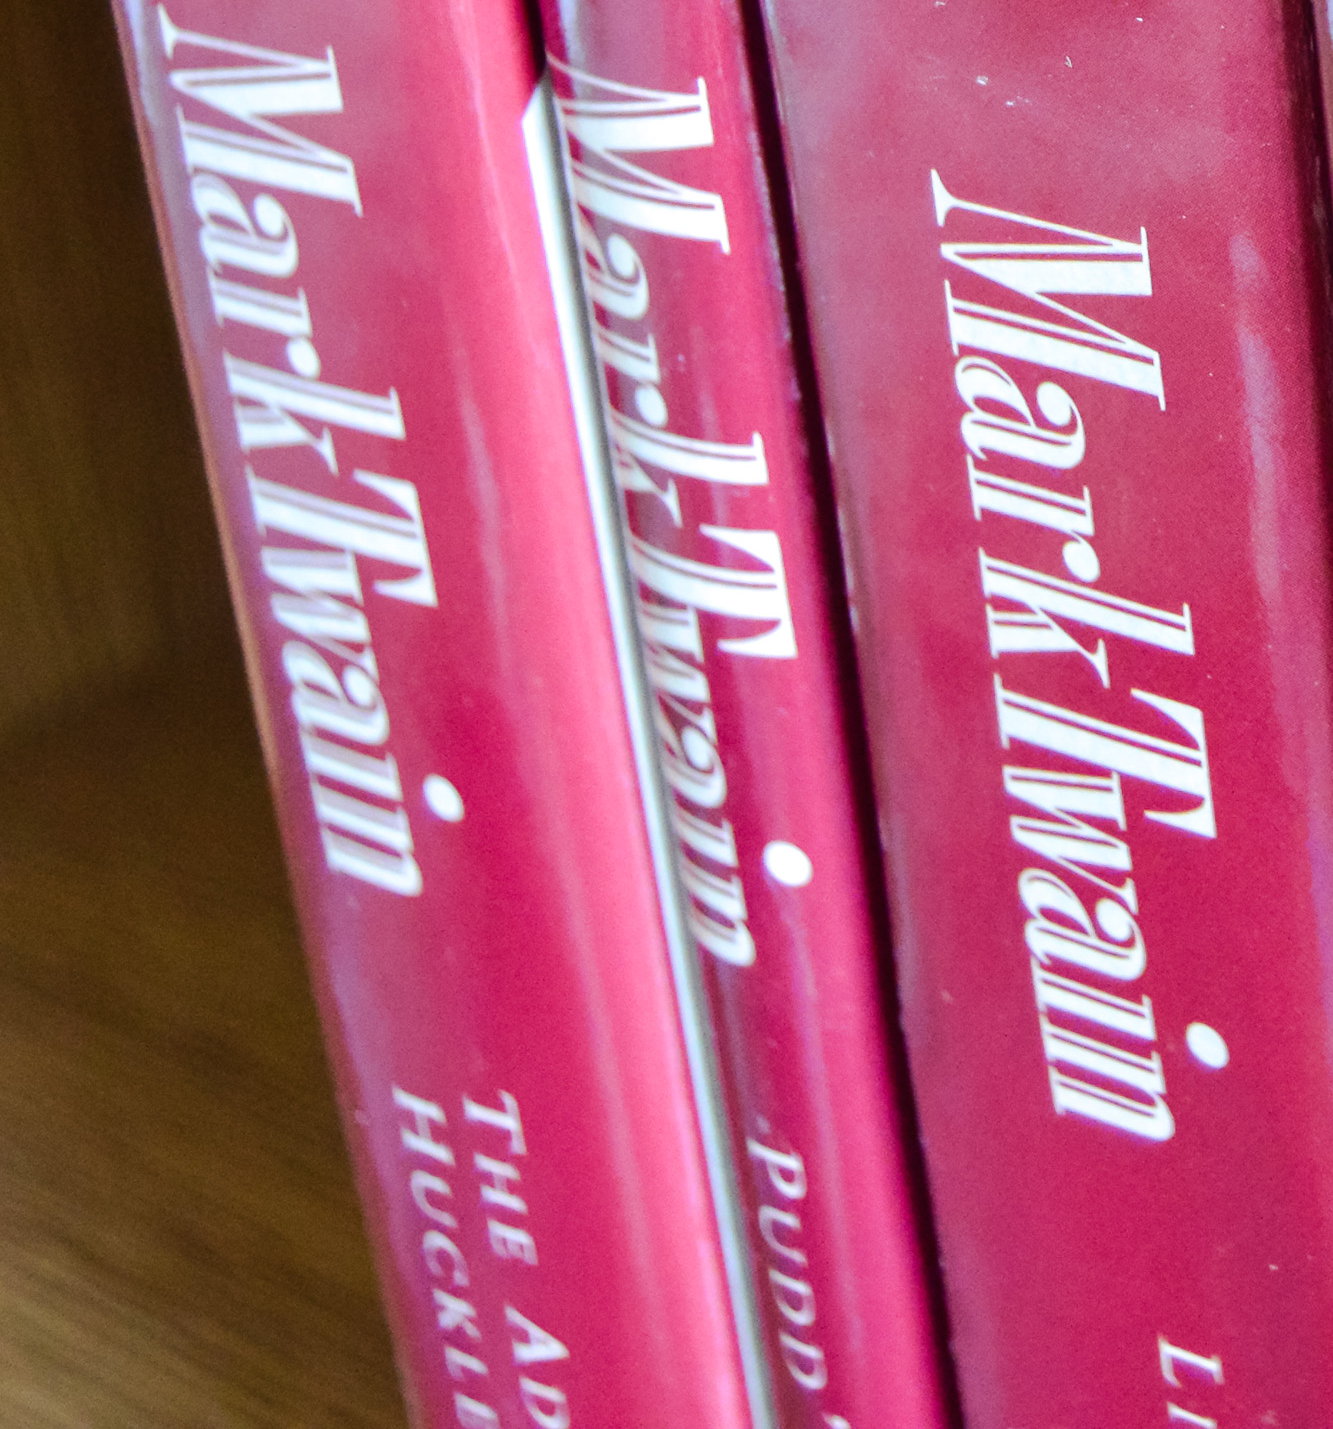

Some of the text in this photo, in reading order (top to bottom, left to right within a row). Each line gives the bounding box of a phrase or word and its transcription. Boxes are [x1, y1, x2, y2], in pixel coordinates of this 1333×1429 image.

[157, 3, 464, 897] Mark Twain
[546, 51, 814, 967] Mark Twain
[931, 169, 1230, 1142] Mark Twain
[462, 1088, 539, 1266] THE
